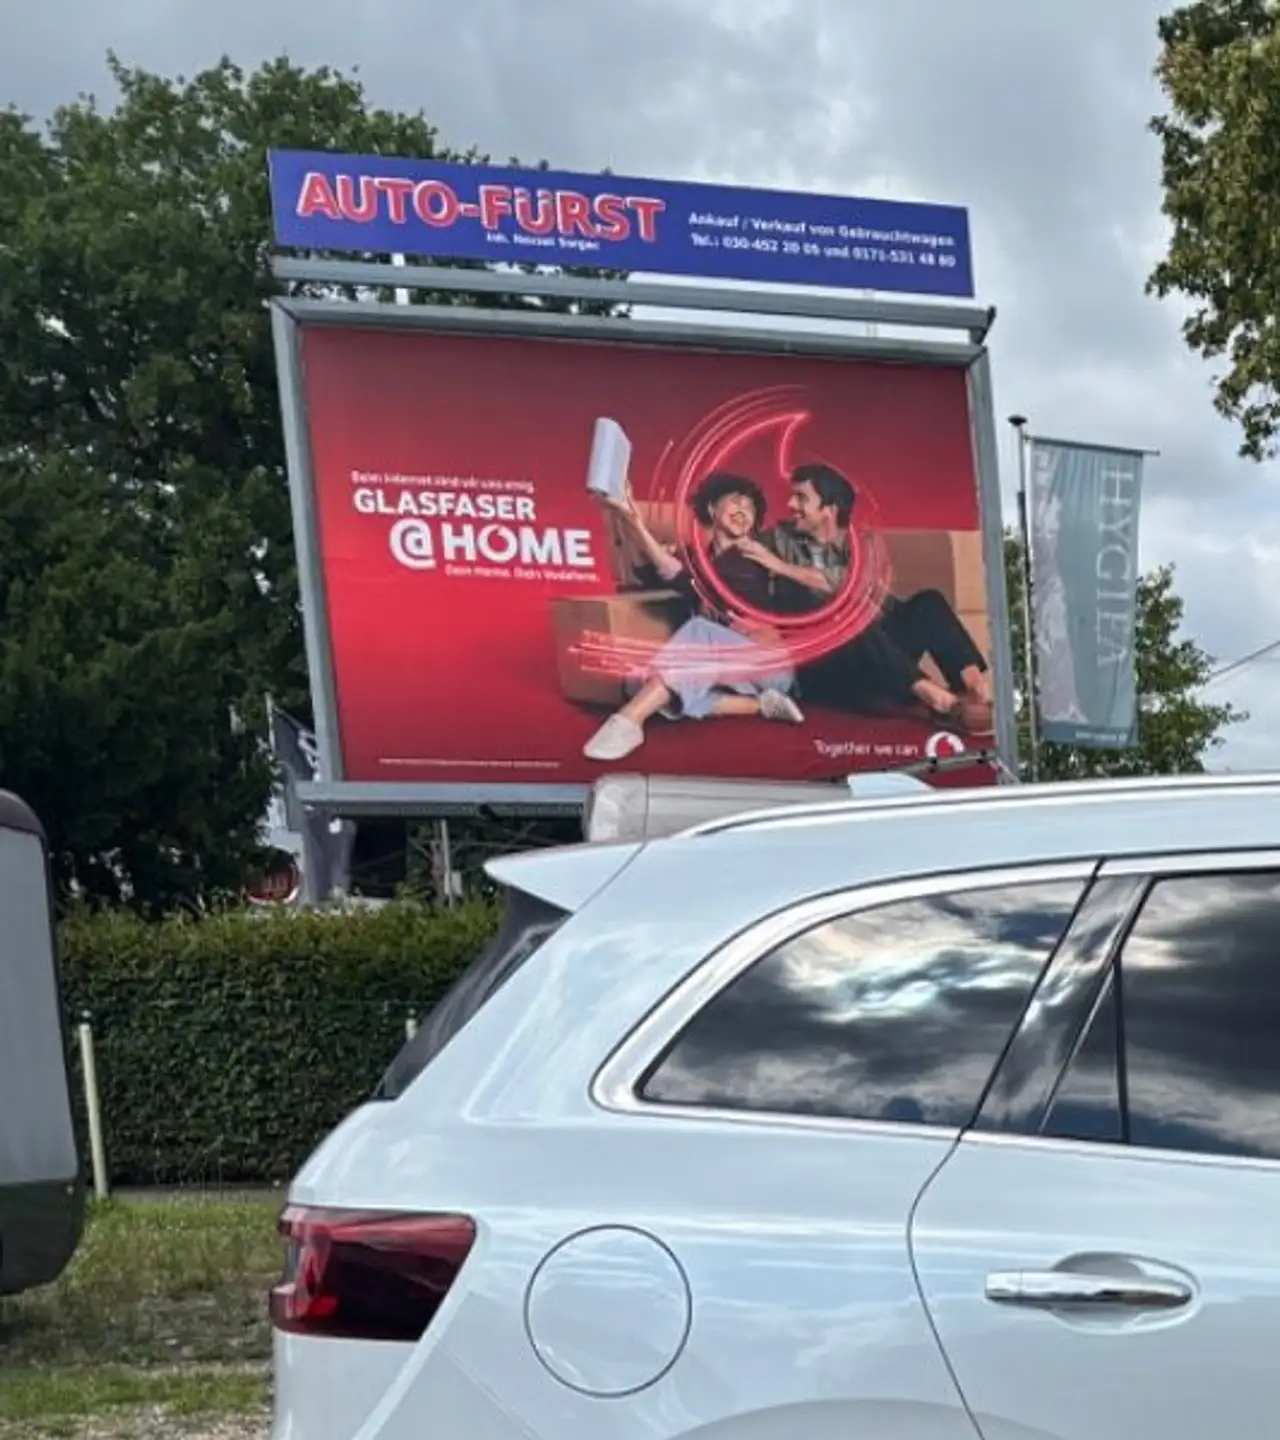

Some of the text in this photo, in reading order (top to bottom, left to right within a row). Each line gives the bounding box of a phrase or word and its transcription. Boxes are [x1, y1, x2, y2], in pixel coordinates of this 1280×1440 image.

[296, 172, 665, 242] AUTO-FÜRST
[689, 212, 739, 228] Ankauf
[750, 217, 806, 233] Verkauf
[808, 224, 835, 237] von
[838, 225, 955, 248] Gebrauchtwagen
[823, 245, 850, 258] und
[354, 489, 537, 520] GLASFASER
[389, 517, 597, 570] @HOME
[813, 738, 919, 759] Together we can
